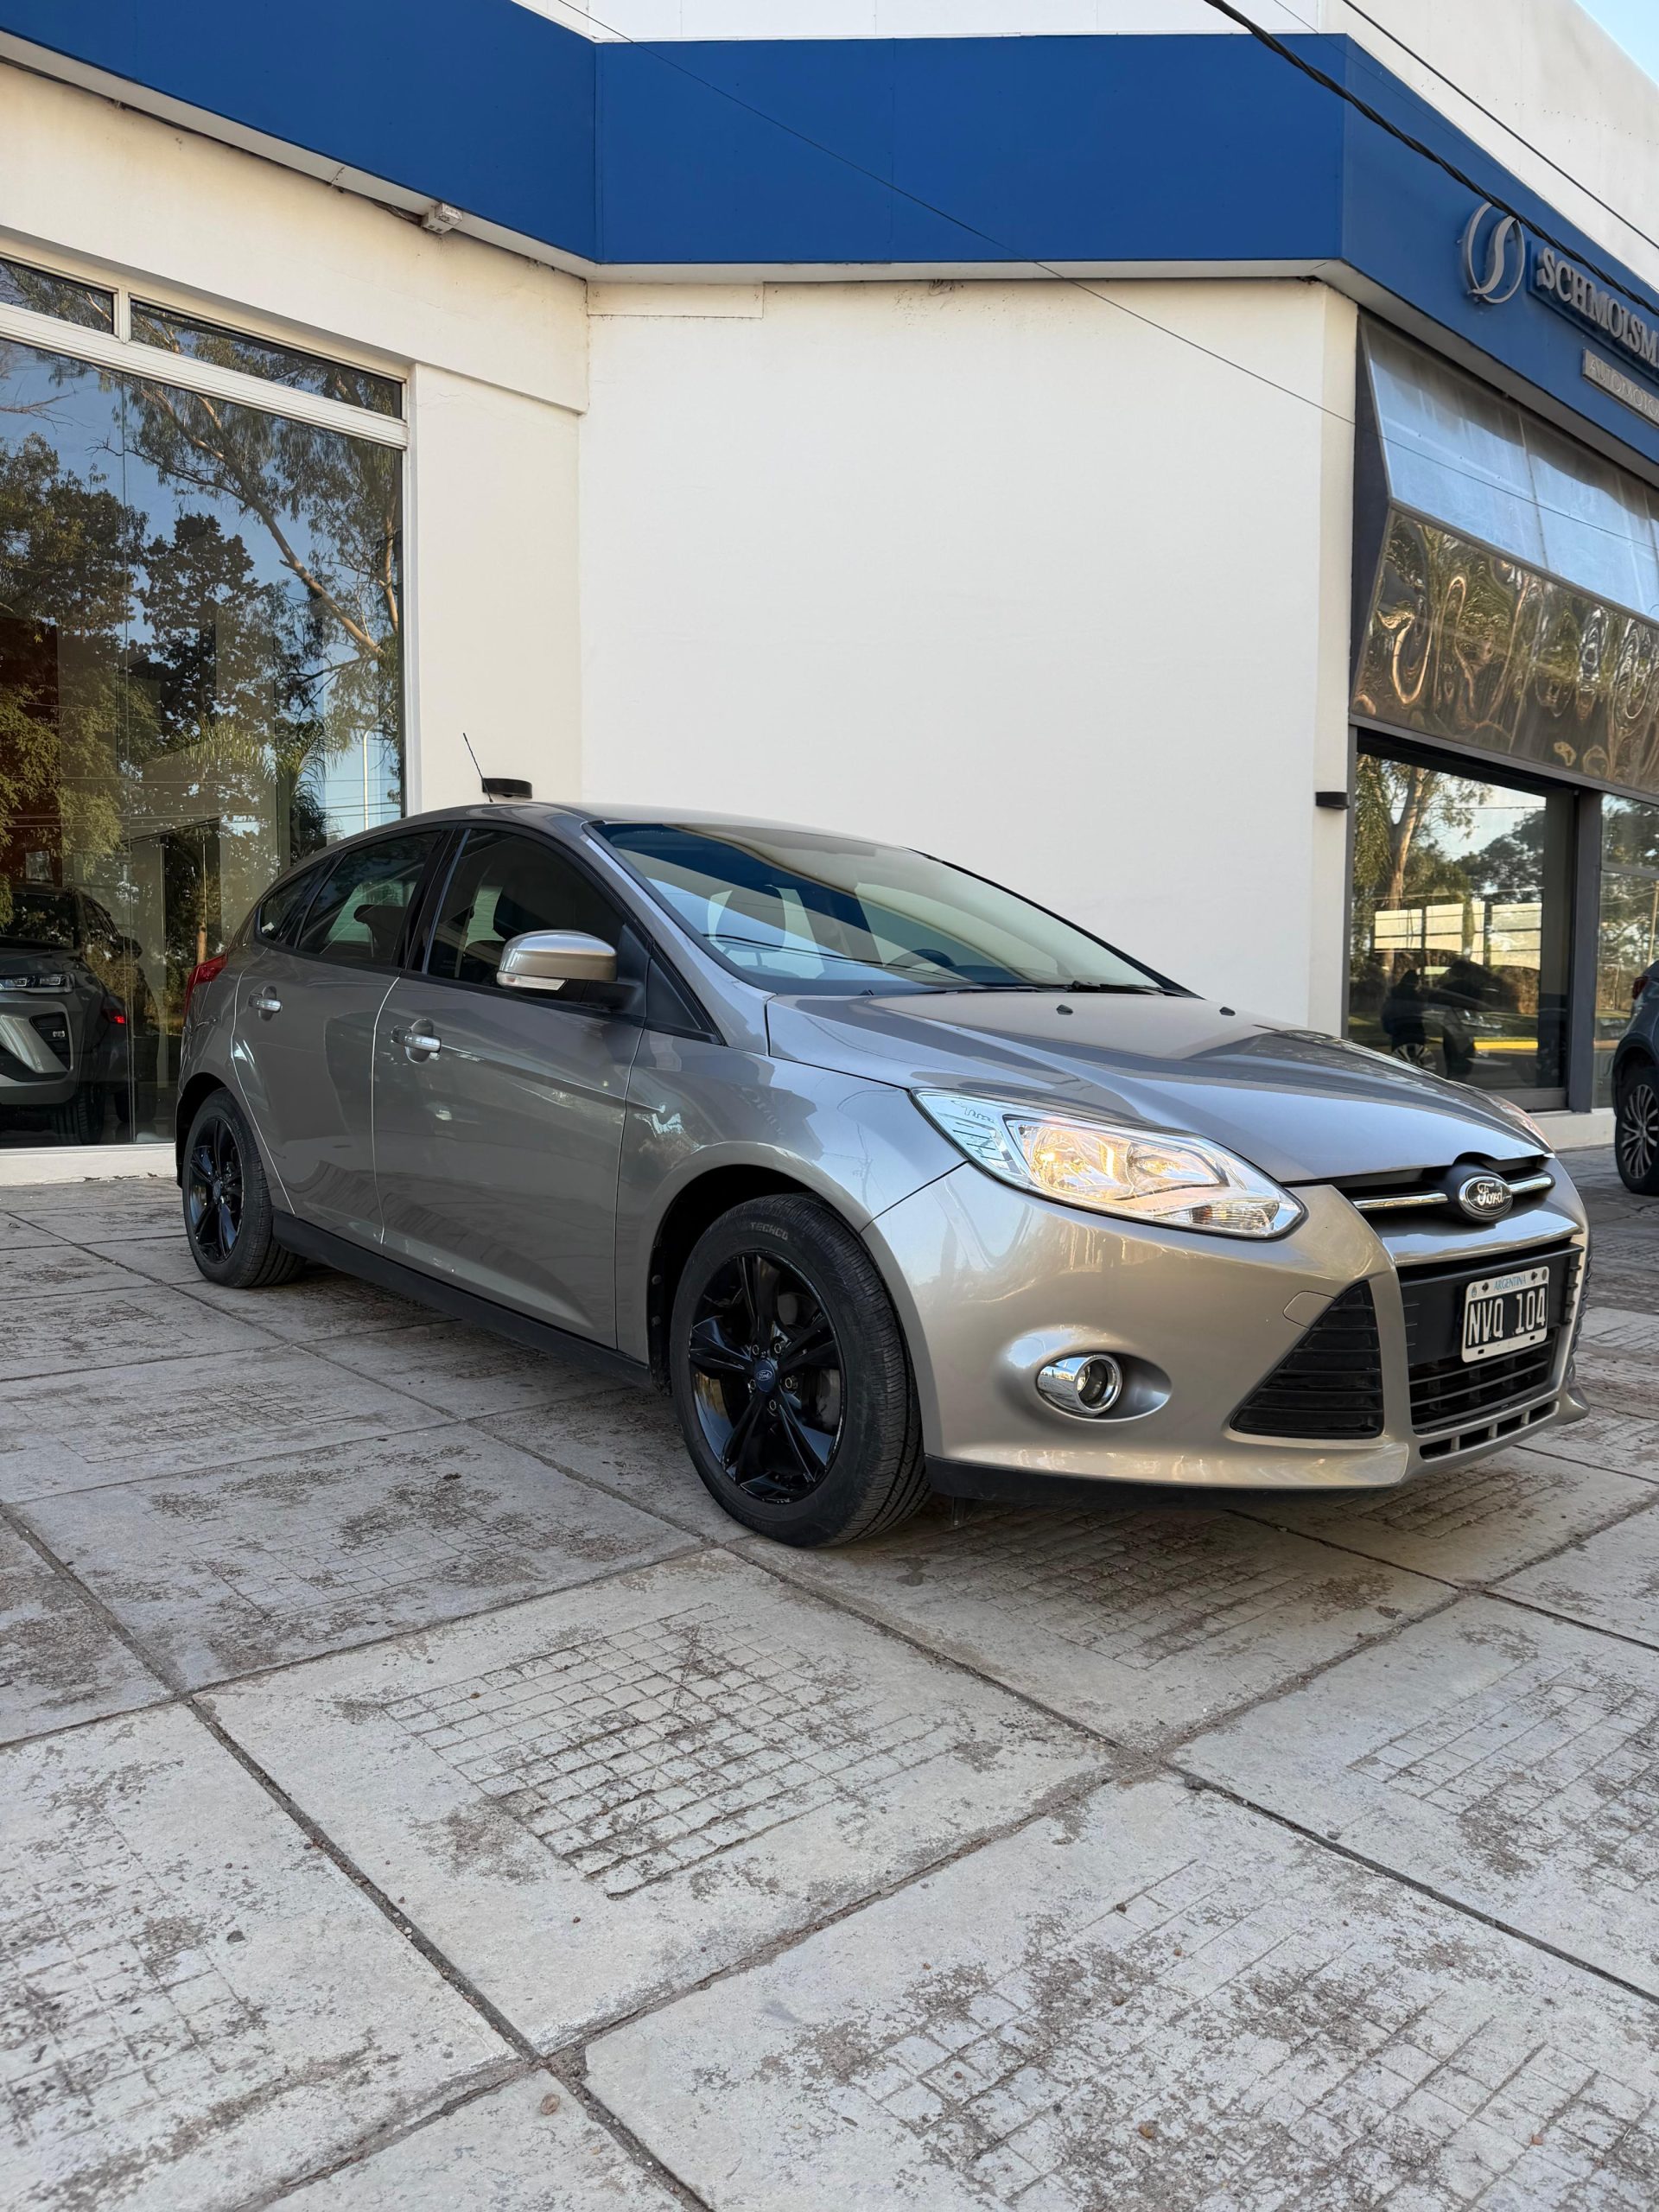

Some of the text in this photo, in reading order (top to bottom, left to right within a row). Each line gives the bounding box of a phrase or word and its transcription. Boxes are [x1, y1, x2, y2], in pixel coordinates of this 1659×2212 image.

[1477, 1182, 1504, 1206] Ford
[1494, 1274, 1527, 1291] ARGENTINA
[1468, 1287, 1546, 1345] NVQ 104
